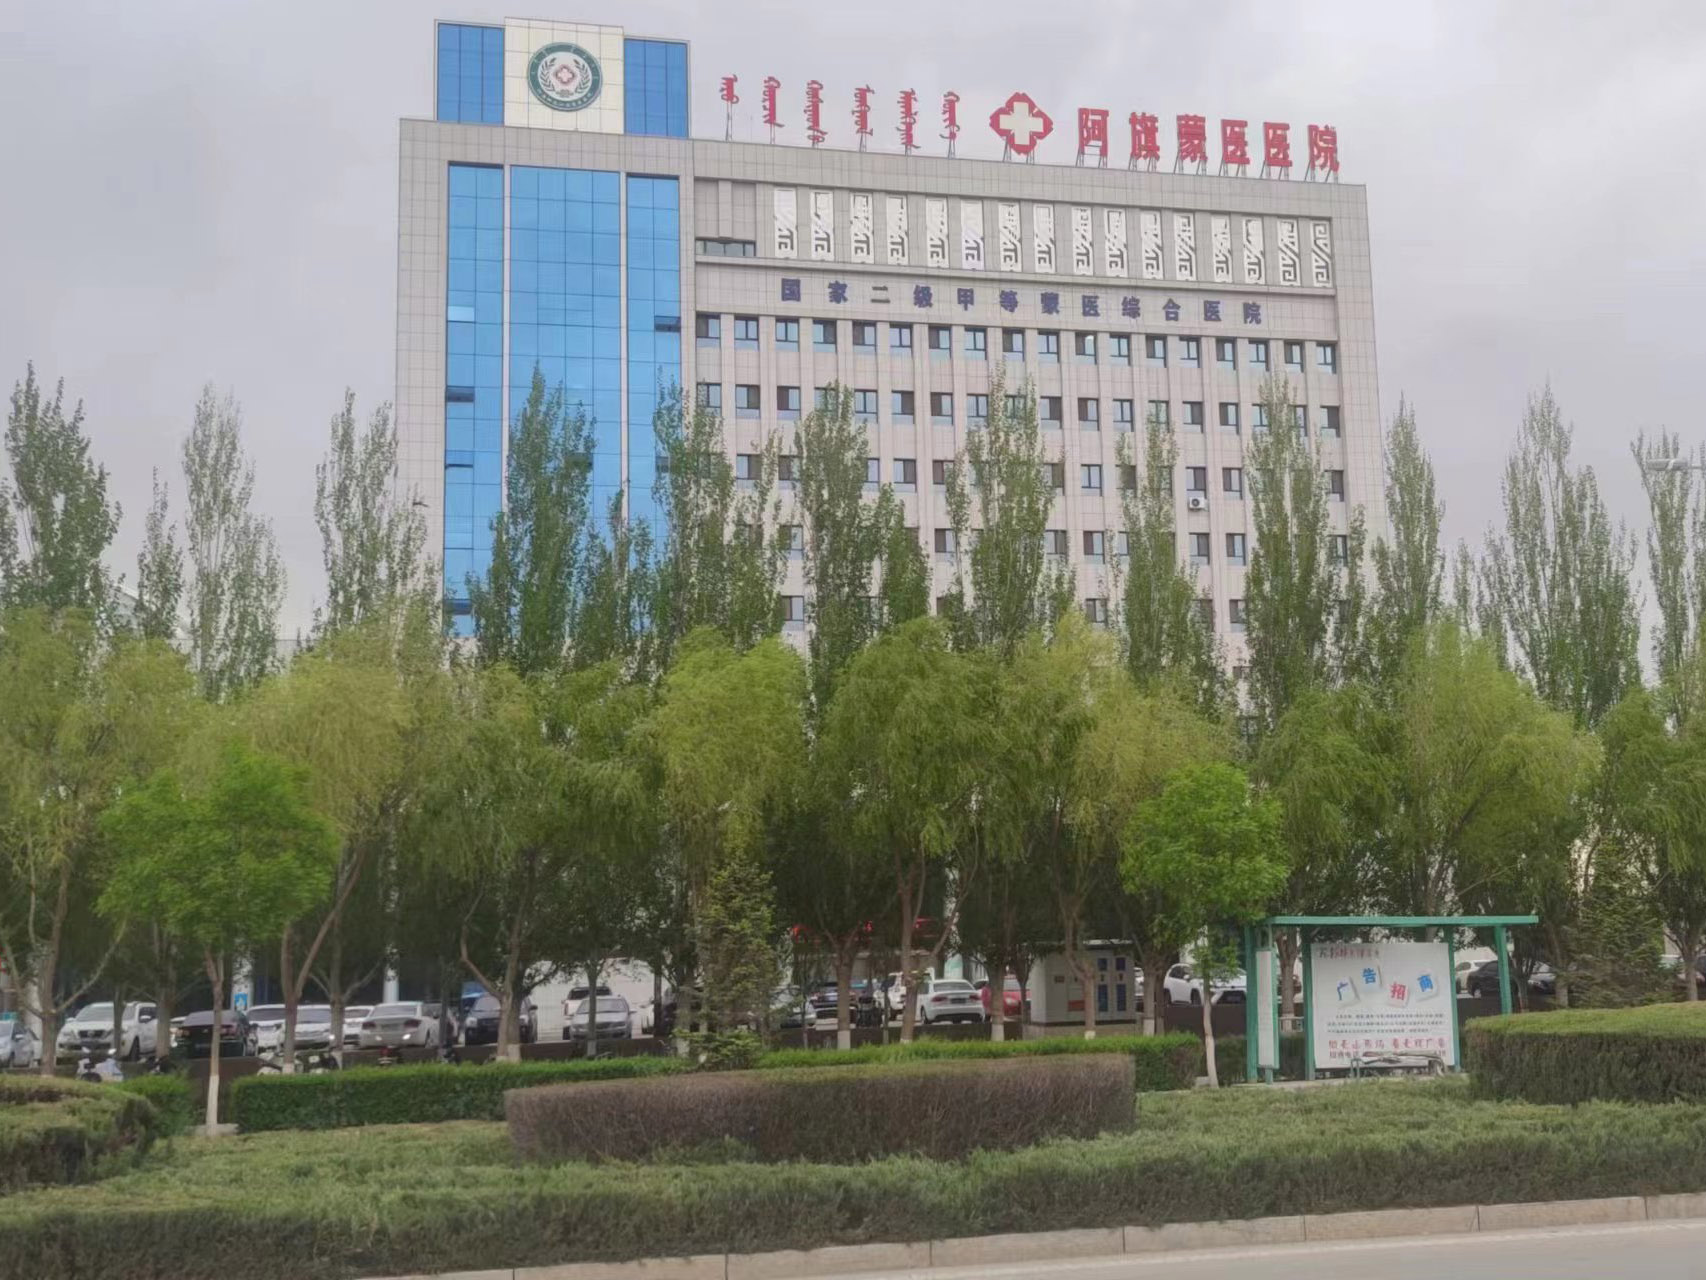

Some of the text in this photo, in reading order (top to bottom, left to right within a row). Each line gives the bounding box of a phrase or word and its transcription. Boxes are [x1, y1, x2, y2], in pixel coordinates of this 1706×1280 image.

[1078, 107, 1340, 172] 阿旗蒙医医院
[781, 278, 1262, 325] 国家二级甲等蒙医综合医院
[1336, 966, 1434, 1001] 广告招商
